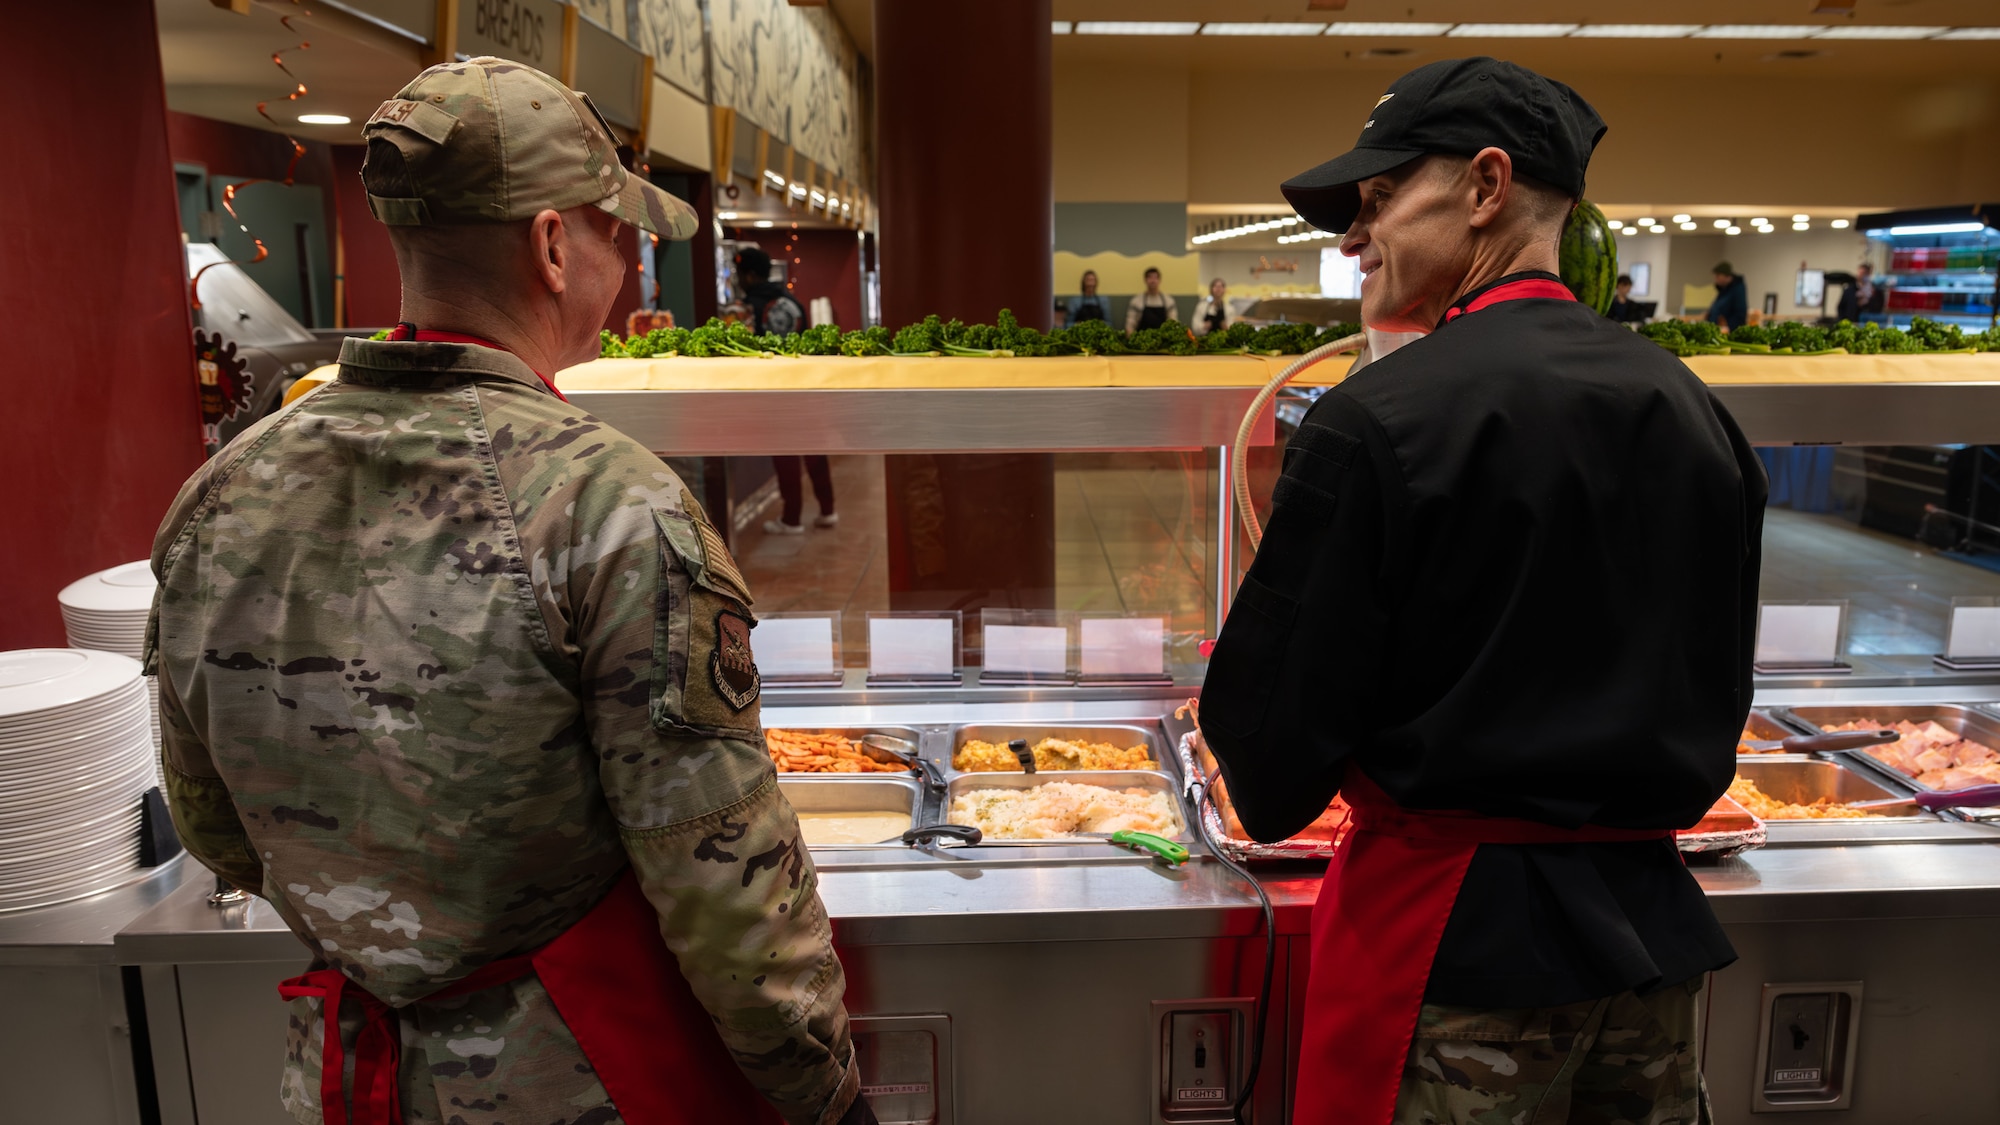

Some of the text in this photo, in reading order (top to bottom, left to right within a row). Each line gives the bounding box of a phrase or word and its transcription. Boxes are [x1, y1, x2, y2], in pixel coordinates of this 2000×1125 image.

[477, 0, 544, 62] BREADS
[1782, 1071, 1813, 1080] LIGHTS
[1184, 1090, 1217, 1098] LIGHTS
